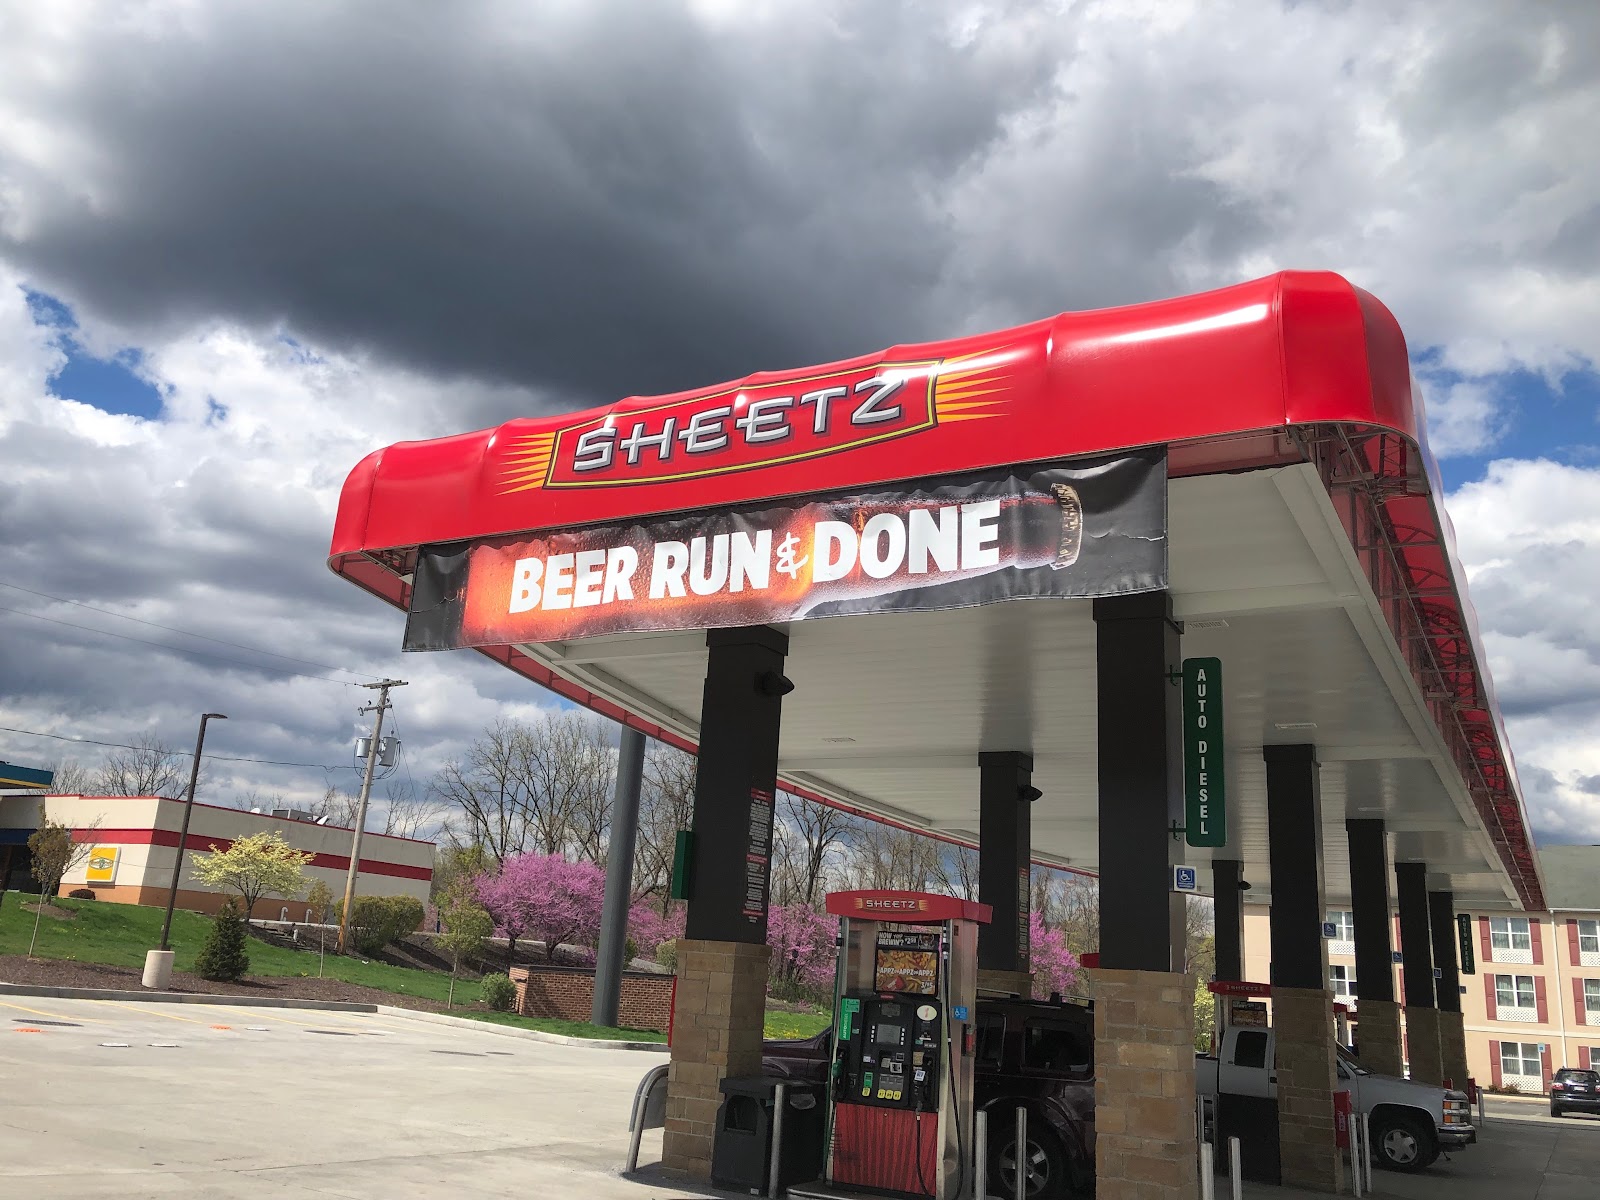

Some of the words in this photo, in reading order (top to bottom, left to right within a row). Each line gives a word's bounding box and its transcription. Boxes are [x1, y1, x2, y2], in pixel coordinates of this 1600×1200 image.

[573, 376, 903, 471] SHEETZ
[509, 546, 638, 614] BEER
[649, 529, 773, 600] RUN
[776, 532, 809, 579] &
[813, 500, 1000, 583] DONE
[1197, 668, 1208, 729] AUTO
[1198, 740, 1209, 835] DIESEL
[866, 899, 916, 909] SHEETZ
